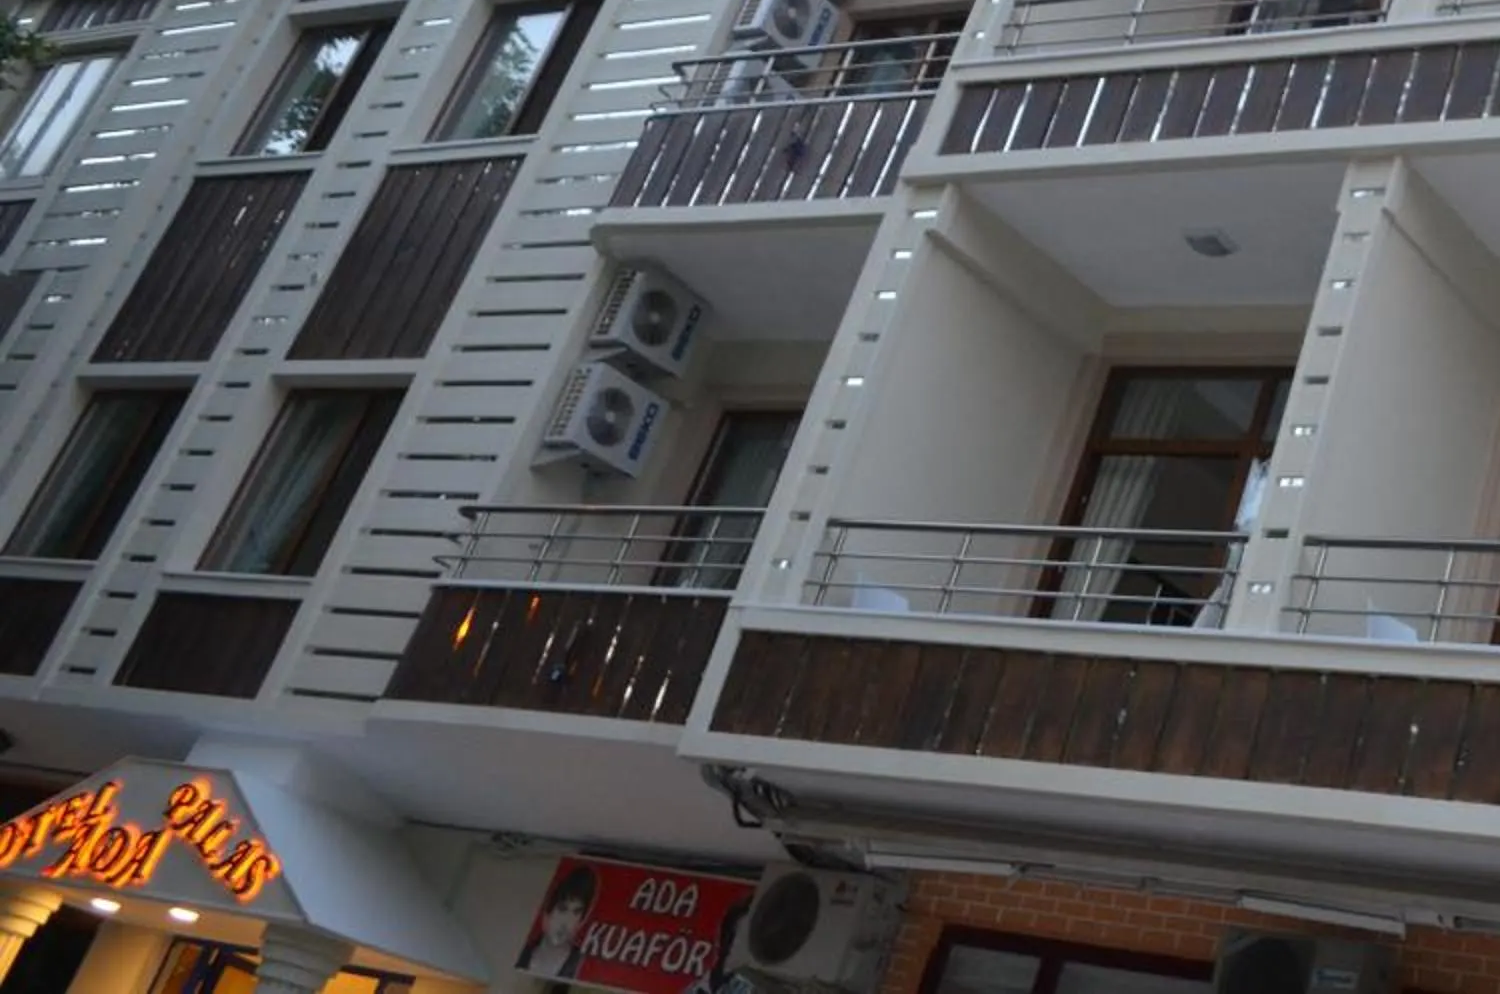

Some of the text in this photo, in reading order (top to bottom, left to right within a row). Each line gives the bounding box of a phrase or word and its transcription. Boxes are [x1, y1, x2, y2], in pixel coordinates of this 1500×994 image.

[42, 822, 170, 888] ADA
[163, 776, 281, 902] PALAS
[629, 876, 699, 918] ADA
[580, 923, 712, 975] KUAFÖR
